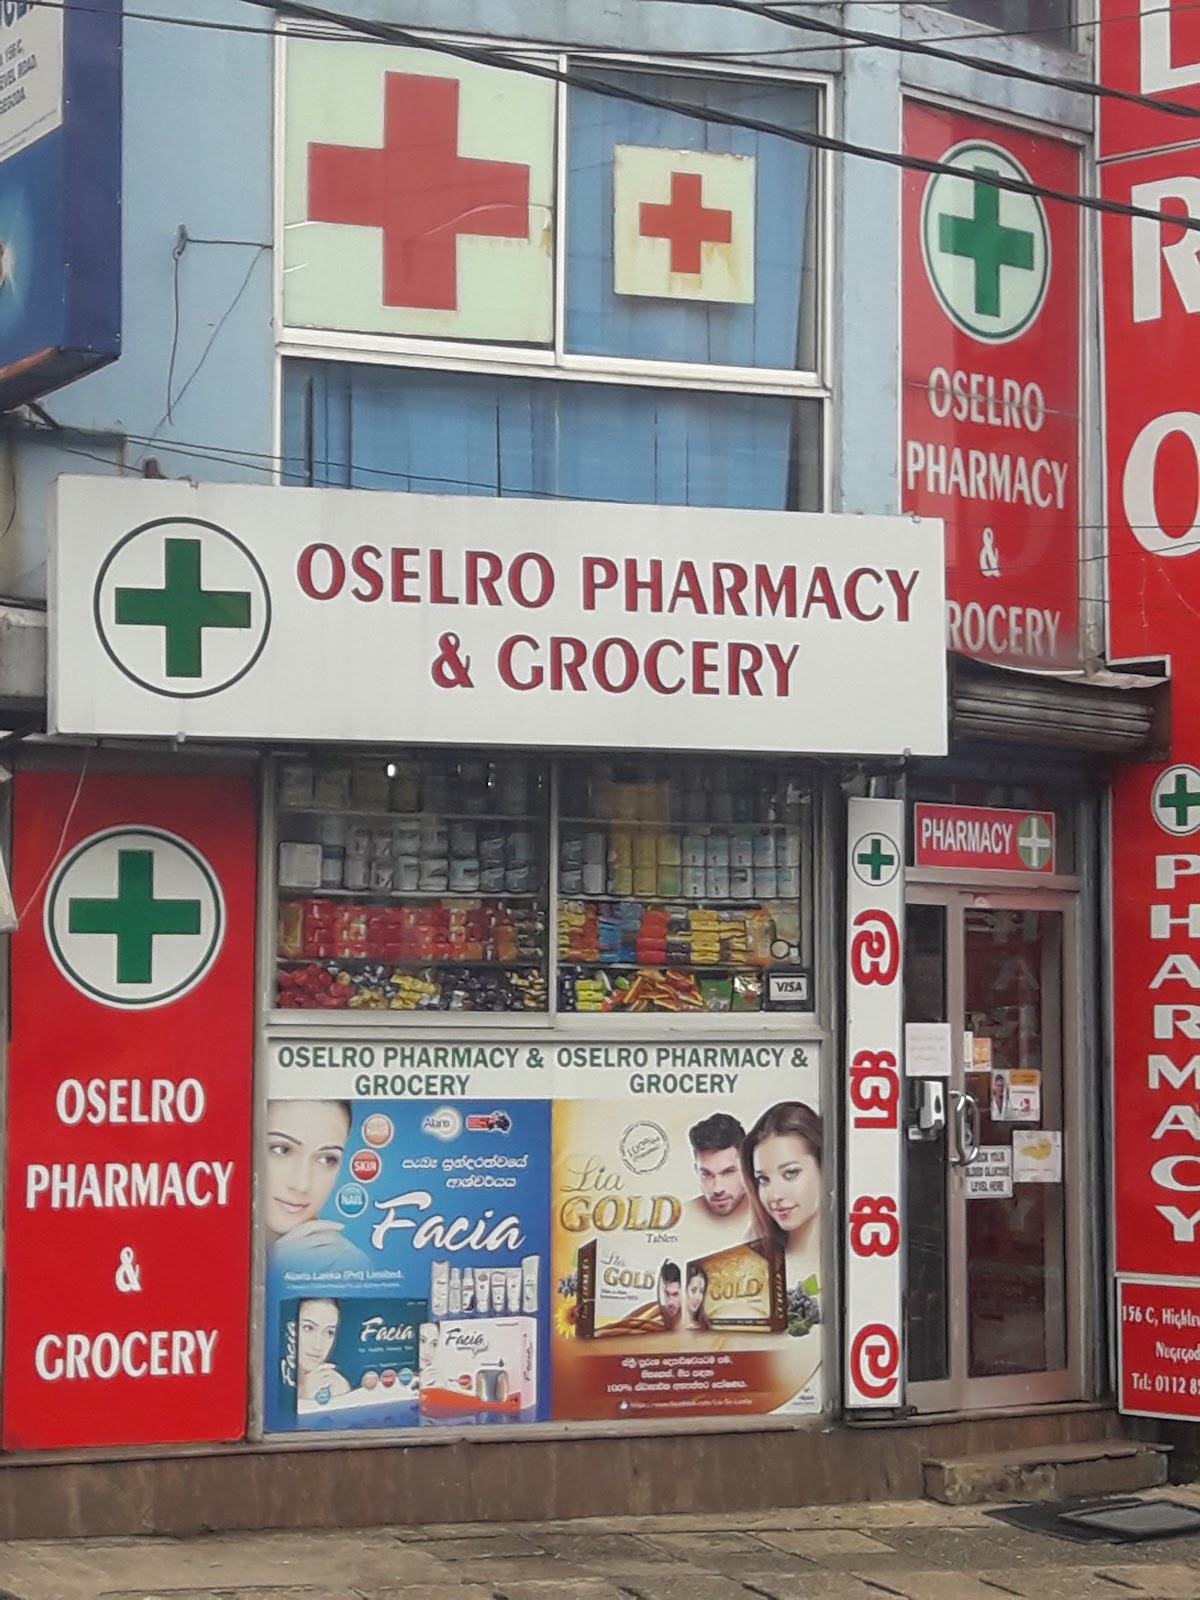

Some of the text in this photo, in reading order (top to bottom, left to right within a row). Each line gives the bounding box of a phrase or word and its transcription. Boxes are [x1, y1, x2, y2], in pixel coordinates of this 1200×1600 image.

[928, 367, 1045, 432] OSELRO
[907, 440, 1068, 510] PHARMACY
[979, 527, 1001, 577] &
[297, 542, 919, 622] OSELRO PHARMACY
[947, 600, 1061, 656] ROCERY
[431, 632, 800, 697] & GROCERY
[922, 817, 1013, 856] PHARMACY
[775, 981, 803, 993] VISA
[277, 1045, 544, 1069] OSELRO PHARMACY &
[556, 1047, 808, 1068] OSELRO PHARMACY &
[56, 1078, 205, 1125] OSELRO
[355, 1074, 471, 1096] GROCERY
[630, 1073, 739, 1094] GROCERY
[26, 1160, 234, 1210] PHARMACY
[353, 1160, 378, 1172] SKIN
[560, 1155, 624, 1192] Lia
[371, 1191, 526, 1250] Facia
[561, 1195, 682, 1233] GOLD
[114, 1246, 142, 1293] &
[603, 1267, 655, 1290] GOLD
[710, 1278, 763, 1301] GOLD
[360, 1317, 414, 1342] Facia
[1122, 1305, 1142, 1323] 156
[1145, 1306, 1158, 1327] C,
[34, 1328, 219, 1380] GROCERY
[280, 1321, 296, 1387] Facia
[445, 1328, 484, 1347] Facia
[1155, 1374, 1186, 1394] 0112
